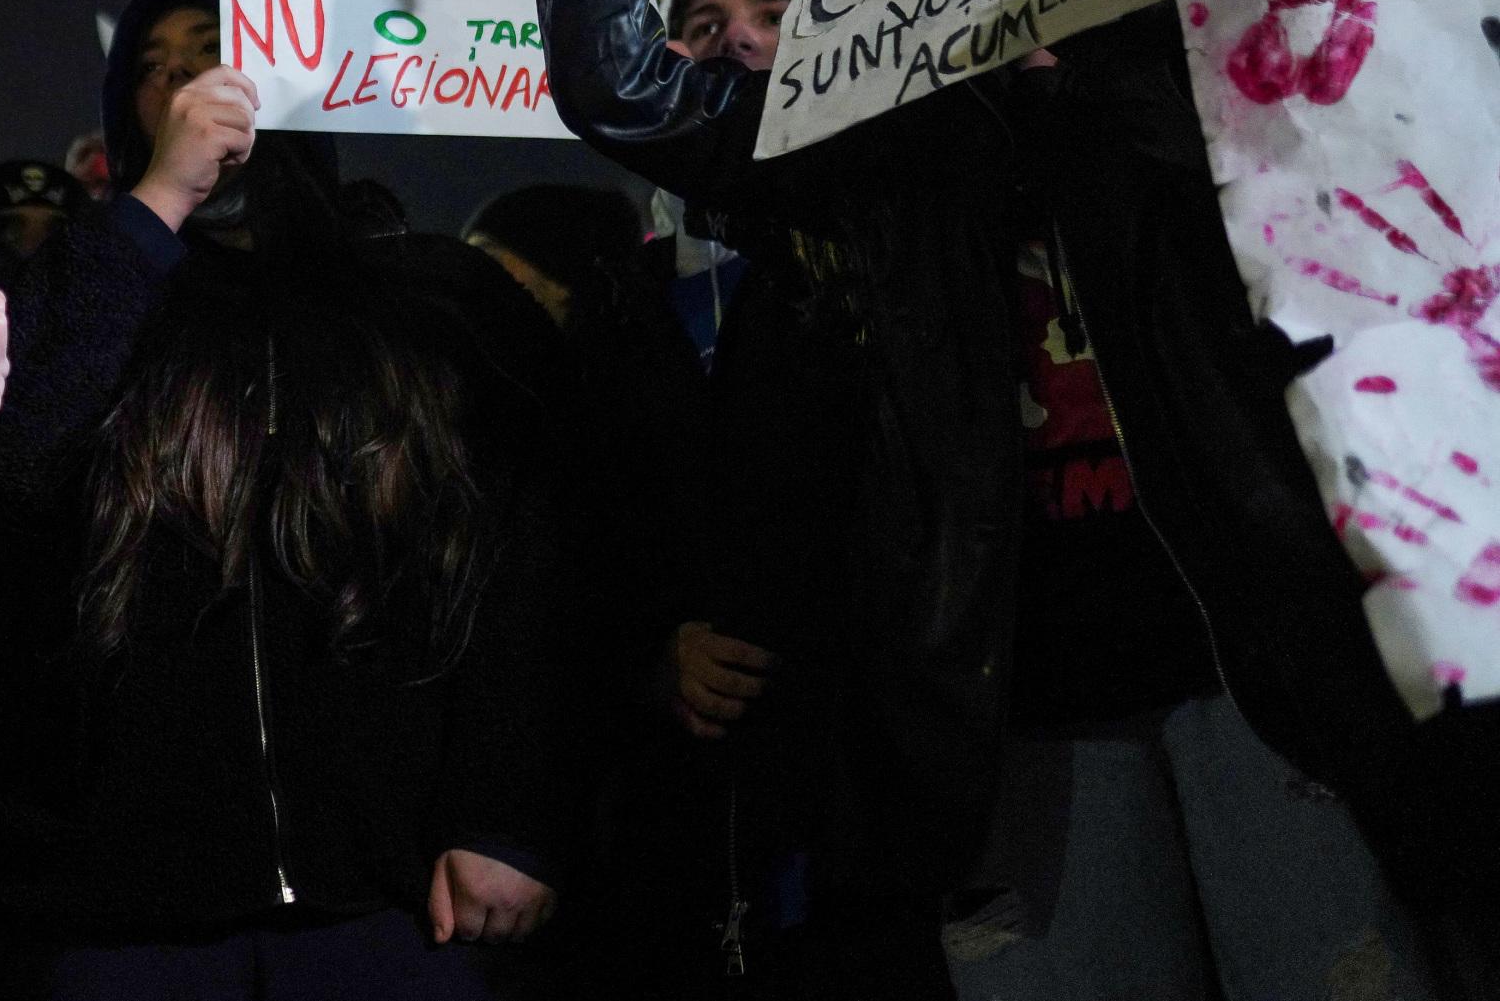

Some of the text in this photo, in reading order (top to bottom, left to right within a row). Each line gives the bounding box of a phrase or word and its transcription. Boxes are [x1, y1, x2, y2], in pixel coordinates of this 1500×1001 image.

[373, 10, 426, 46] O
[466, 19, 545, 62] ȚAR
[779, 21, 902, 110] SUNT
[894, 0, 1042, 106] ACUM
